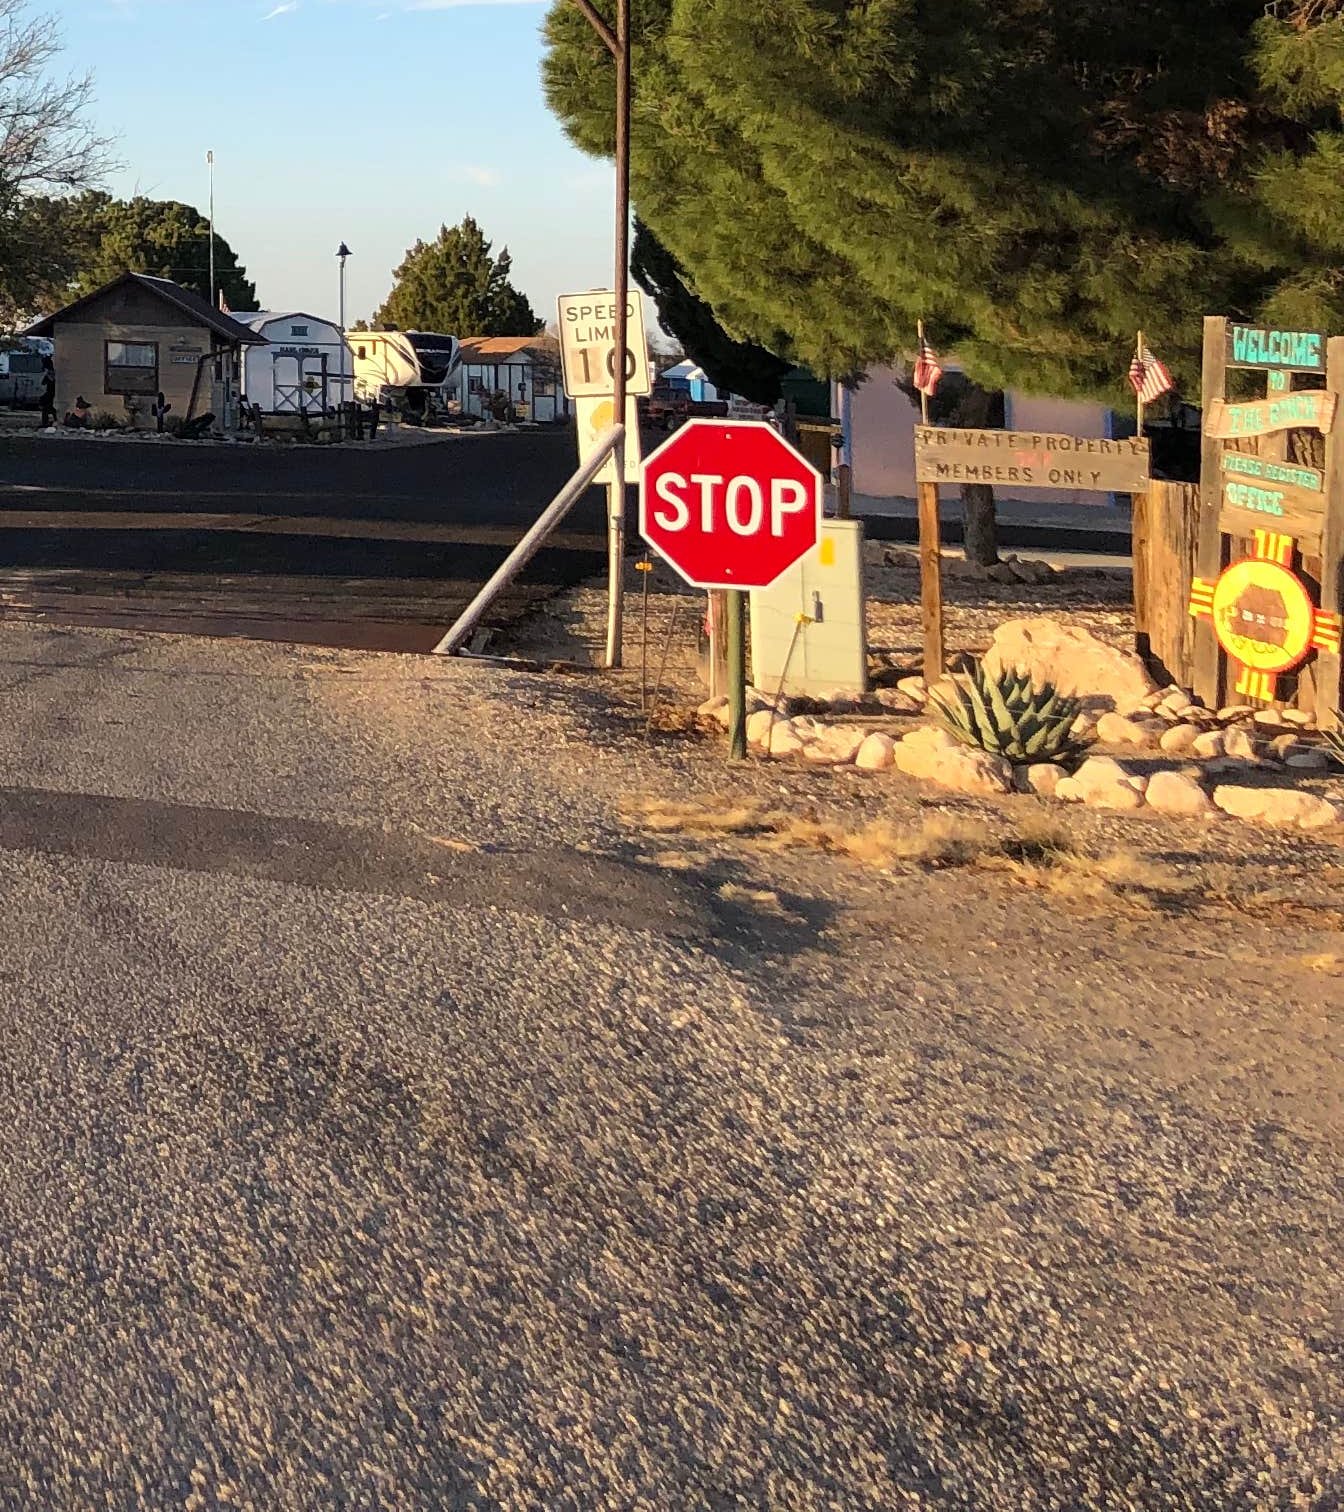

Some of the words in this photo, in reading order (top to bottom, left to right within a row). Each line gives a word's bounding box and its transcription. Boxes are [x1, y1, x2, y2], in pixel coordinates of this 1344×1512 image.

[578, 346, 637, 383] 10
[1233, 326, 1321, 367] WELCOME
[1271, 369, 1285, 391] TO
[1227, 407, 1263, 435] THE
[1269, 394, 1317, 426] RANCH
[922, 429, 1017, 449] PRIVATE
[1031, 435, 1140, 456] PROPERTY
[936, 462, 1033, 482] MEMBERS
[1048, 469, 1102, 485] ONLY
[654, 472, 808, 537] STOP
[1226, 482, 1284, 517] OFFICE
